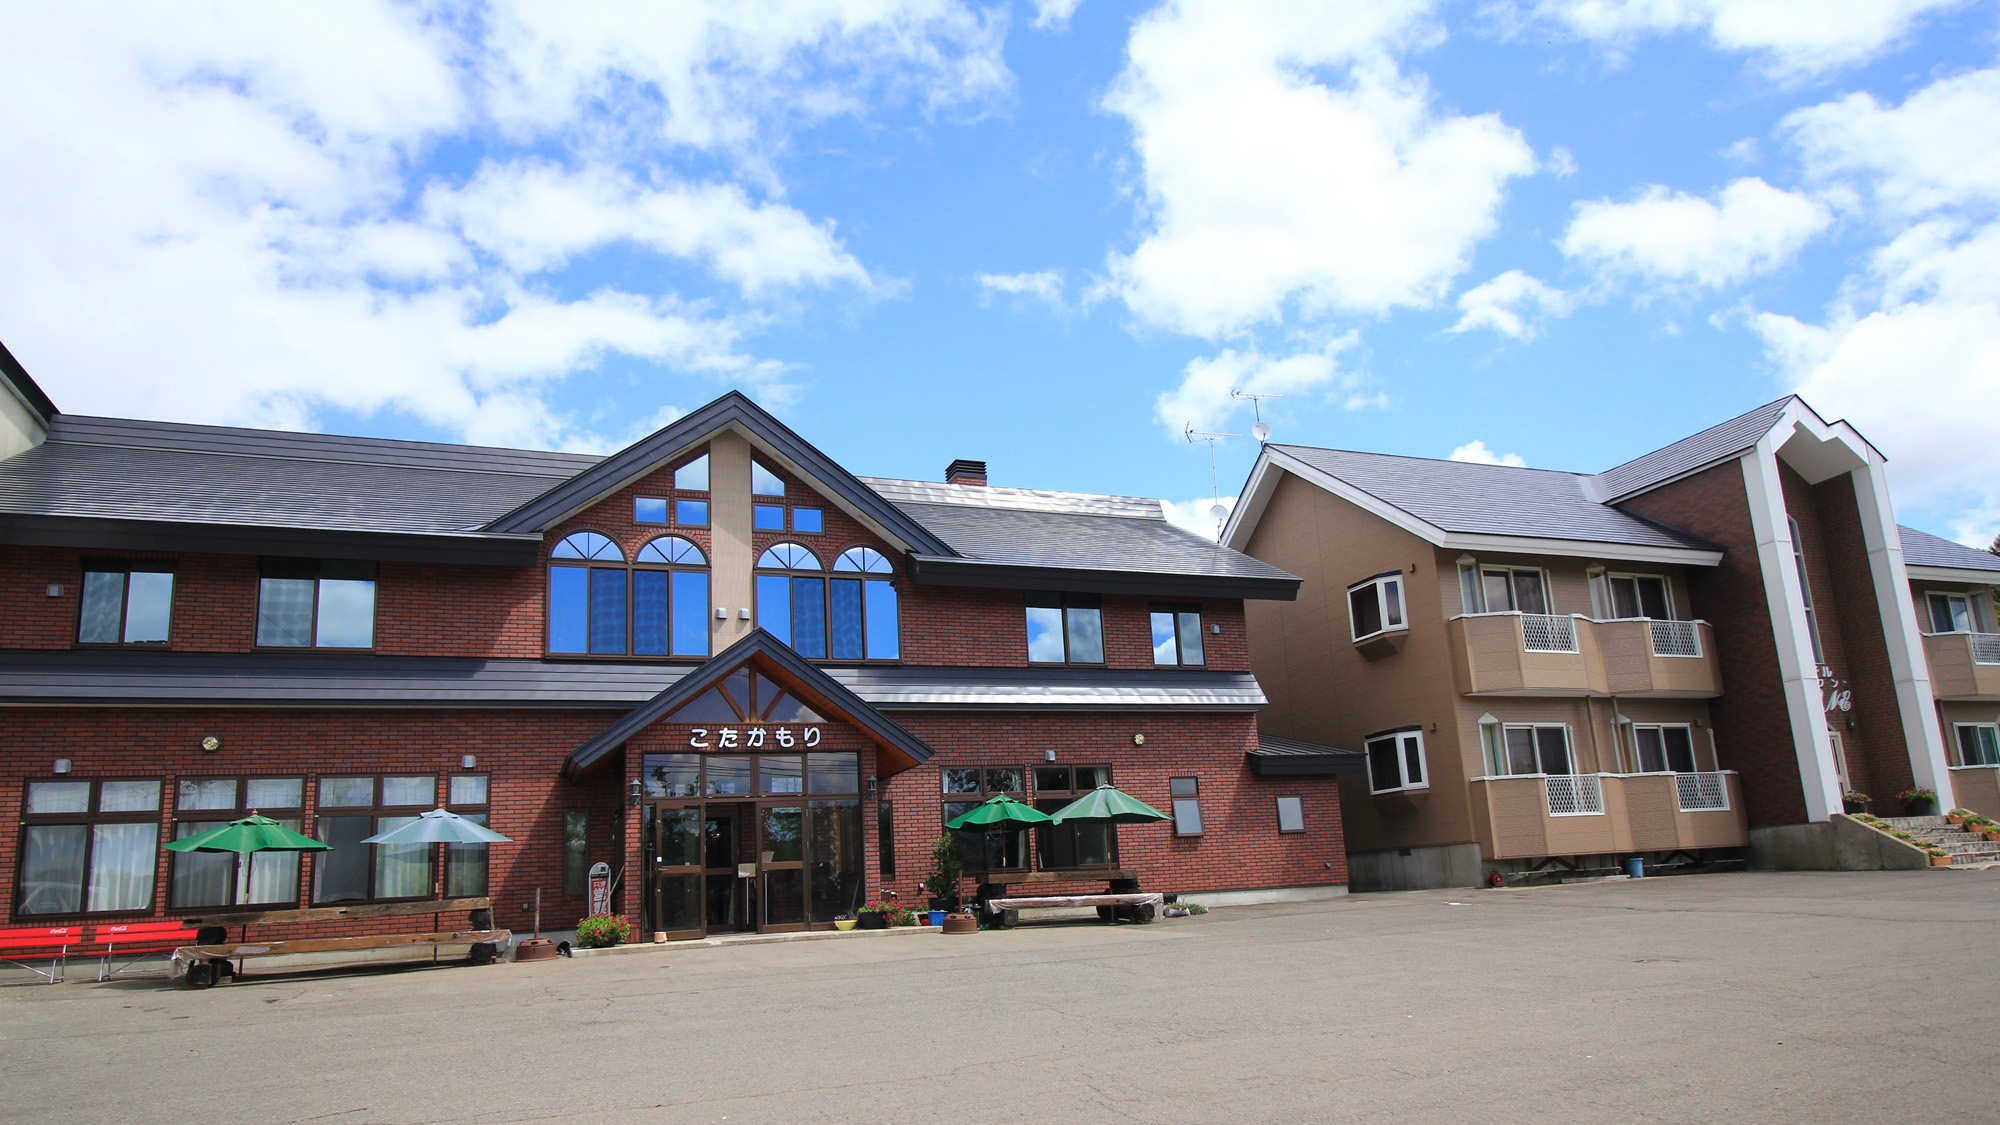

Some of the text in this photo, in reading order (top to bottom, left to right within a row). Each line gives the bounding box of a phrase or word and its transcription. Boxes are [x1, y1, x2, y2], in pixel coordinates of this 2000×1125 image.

[1821, 687, 1851, 711] NE
[690, 726, 821, 748] こたかもり
